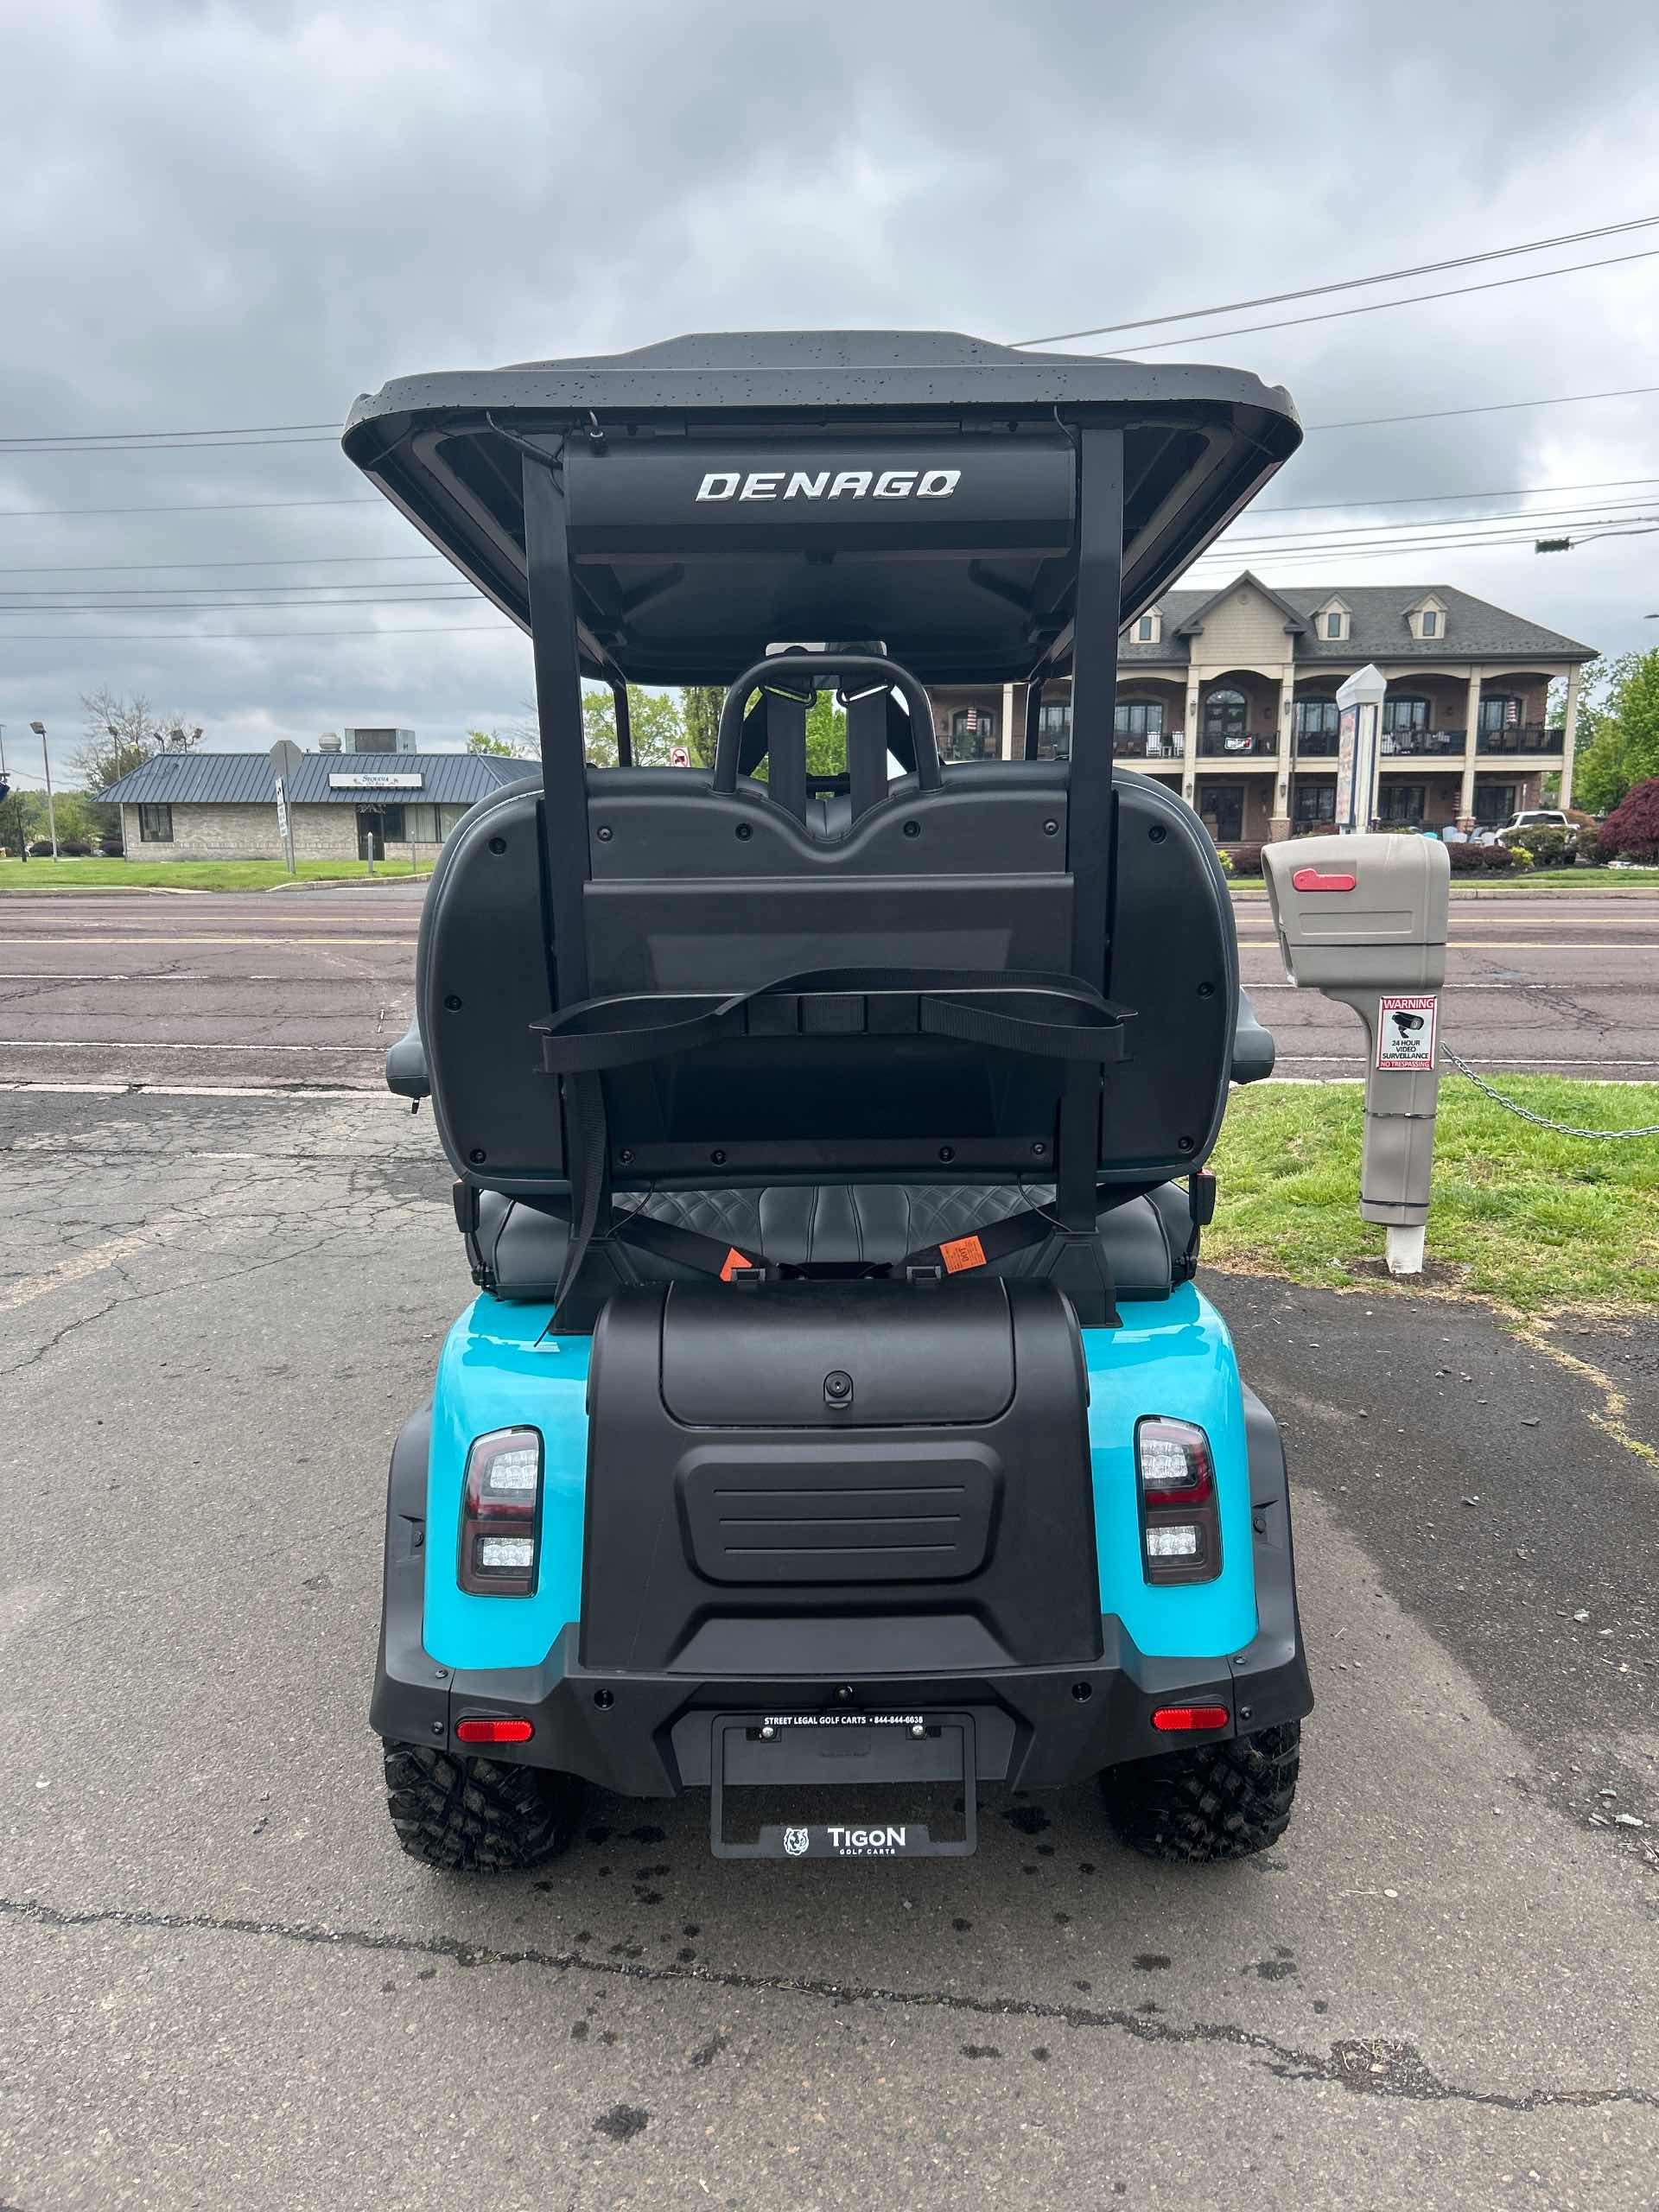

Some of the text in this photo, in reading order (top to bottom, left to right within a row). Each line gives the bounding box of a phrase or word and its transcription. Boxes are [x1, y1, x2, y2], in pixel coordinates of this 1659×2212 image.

[695, 470, 962, 502] DENAGO
[1383, 999, 1434, 1009] WARNING
[819, 1716, 840, 1725] GOLF
[841, 1716, 867, 1725] CARTS
[827, 1827, 906, 1847] TIGON
